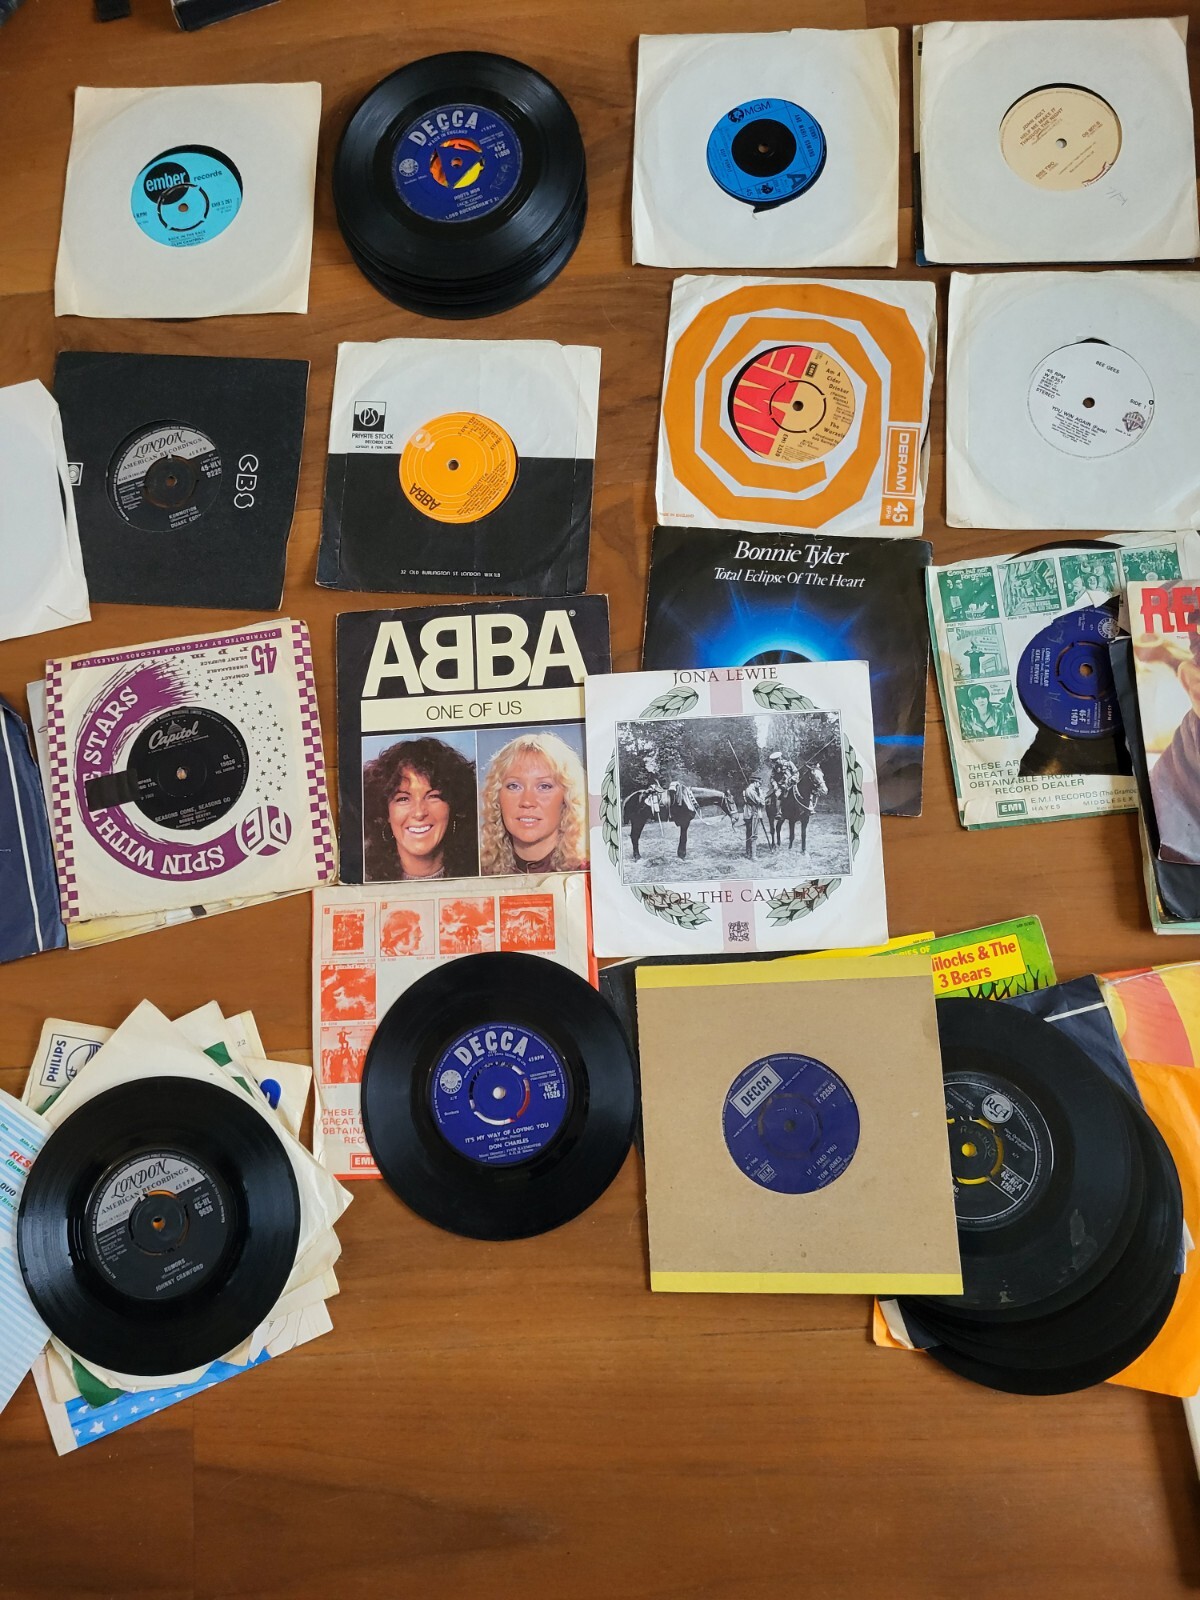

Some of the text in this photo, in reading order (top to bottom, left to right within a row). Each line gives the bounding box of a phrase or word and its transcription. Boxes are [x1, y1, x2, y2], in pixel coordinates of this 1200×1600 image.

[745, 101, 770, 116] MGM
[408, 110, 478, 146] DECCA
[146, 170, 222, 191] ember records
[827, 376, 840, 384] Cider
[829, 384, 849, 394] Drinker
[1036, 388, 1055, 399] STEREO
[1130, 399, 1141, 407] SIDE
[1063, 411, 1074, 419] WIN
[1075, 417, 1091, 426] AGAIN
[123, 439, 202, 470] AMERICAN RECORDINGS
[133, 431, 186, 458] LONDON
[896, 432, 909, 490] DERAM
[234, 454, 258, 509] CBS
[409, 483, 441, 511] ABBA
[892, 502, 908, 522] 45
[734, 541, 849, 569] Bonnie Tyler
[714, 567, 865, 588] Total Eclipse Of The Heart
[194, 642, 208, 650] PYE
[225, 631, 276, 645] DISTRIBUTED
[251, 643, 277, 675] 45
[362, 610, 588, 697] ABBA
[221, 673, 249, 681] COMPACT
[674, 668, 778, 686] JONA LEWIE
[426, 700, 522, 720] ONE OF US
[83, 686, 138, 766] STARS
[148, 720, 199, 750] Capitol
[967, 761, 1001, 771] THESE
[969, 770, 1005, 780] GREAT
[970, 775, 1038, 789] OBTAINABLE
[995, 779, 1084, 794] RECORD DEALER
[1031, 797, 1133, 812] HAYES MIDDLESEX
[1055, 791, 1098, 802] RECORDS
[1001, 803, 1022, 813] EMI
[99, 816, 226, 875] SPIN WITH
[645, 885, 829, 905] STOP THE CAVALRY
[978, 945, 990, 960] &
[989, 941, 1016, 957] The
[938, 966, 992, 988] 3 Bears
[237, 1039, 246, 1047] 22
[454, 1031, 528, 1066] DECCA
[47, 1040, 67, 1083] PHILIPS
[741, 1075, 772, 1107] DECCA
[986, 1098, 1010, 1118] RCA
[322, 1117, 355, 1125] GREAT
[487, 1132, 500, 1140] WAY
[513, 1125, 534, 1134] LOVING
[537, 1122, 549, 1130] YOU
[505, 1138, 529, 1147] CHARLES
[355, 1157, 375, 1165] EMI
[111, 1159, 170, 1198] LONDON
[101, 1166, 189, 1214] AMERICAN RECORDINGS
